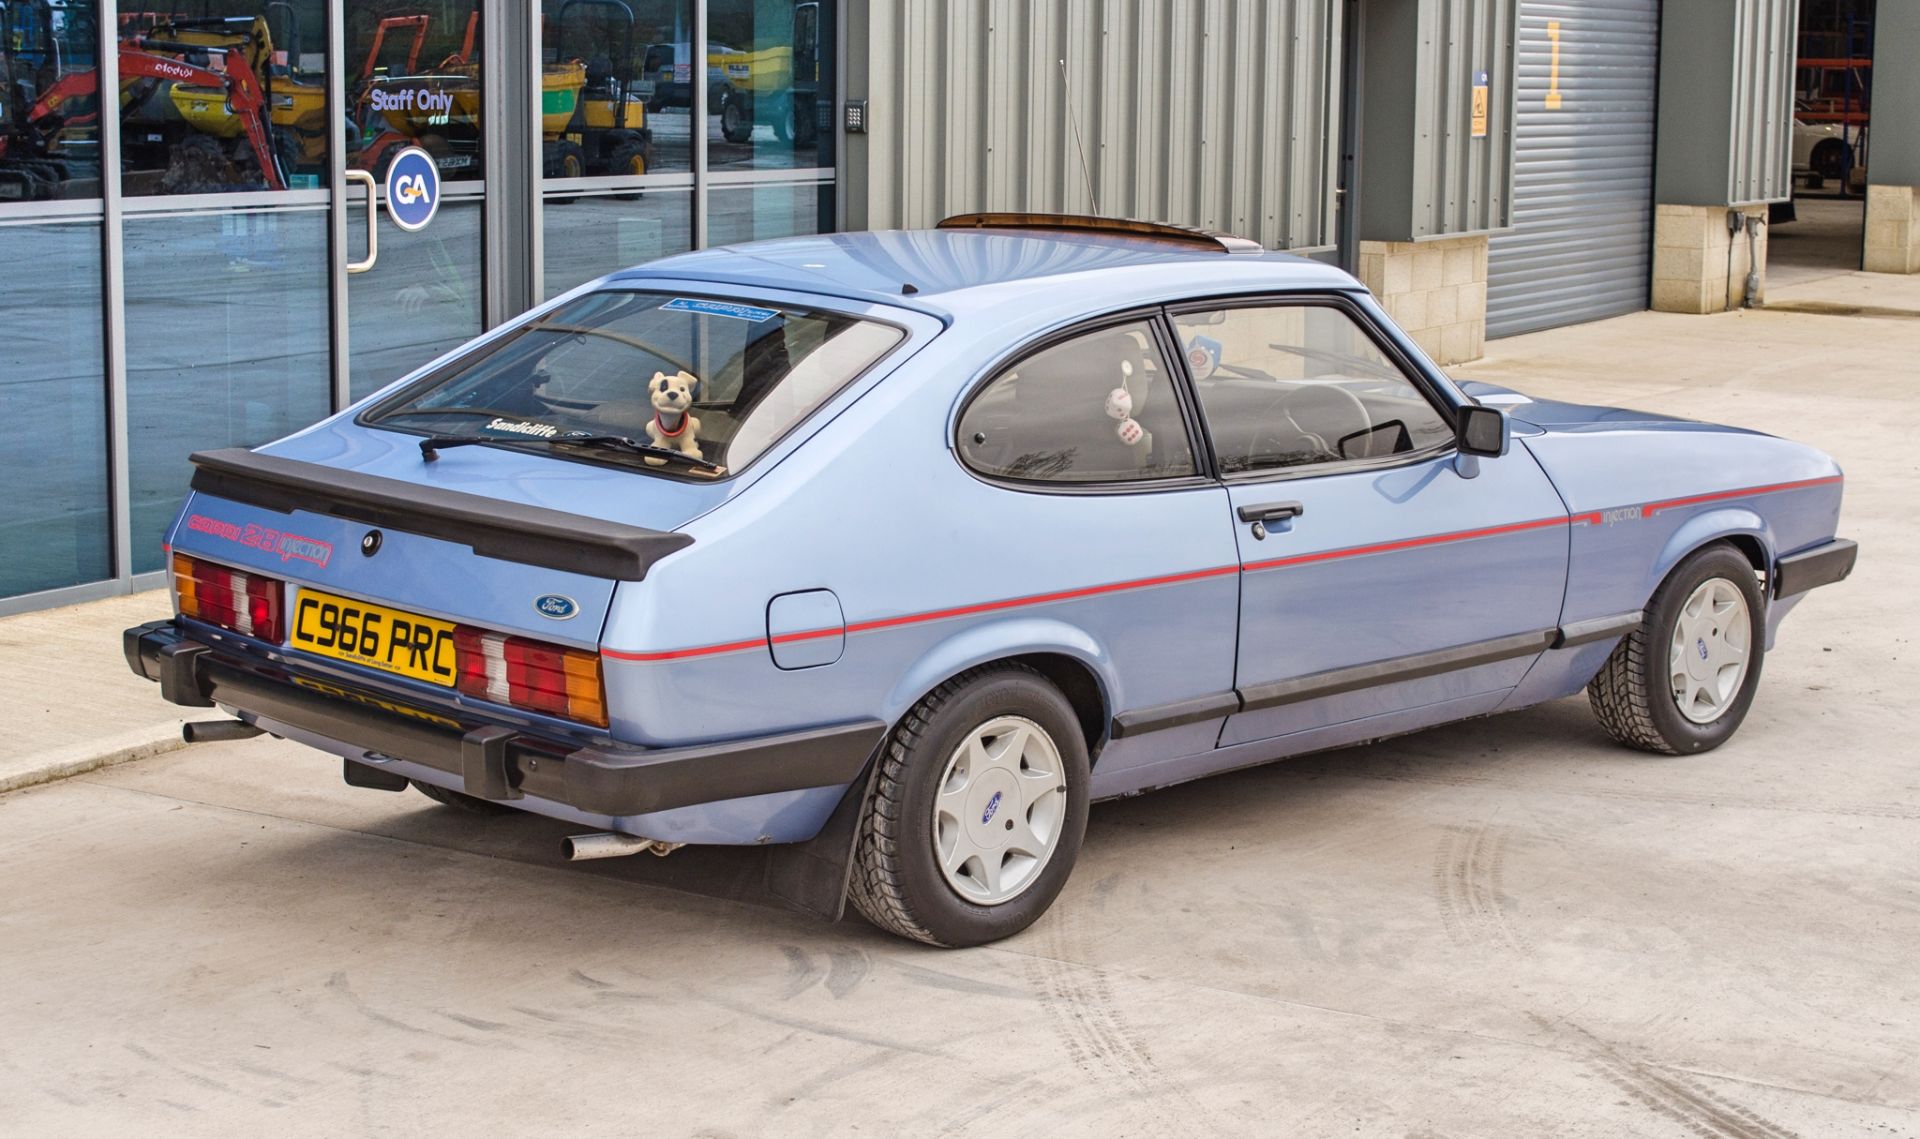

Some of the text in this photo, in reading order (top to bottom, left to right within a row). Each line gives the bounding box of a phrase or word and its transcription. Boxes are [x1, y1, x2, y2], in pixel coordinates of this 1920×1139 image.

[1545, 22, 1562, 110] 1
[371, 88, 454, 115] Staff Only
[395, 174, 431, 205] GA
[486, 418, 557, 438] Sandicliffe
[296, 598, 454, 677] C966 PRC
